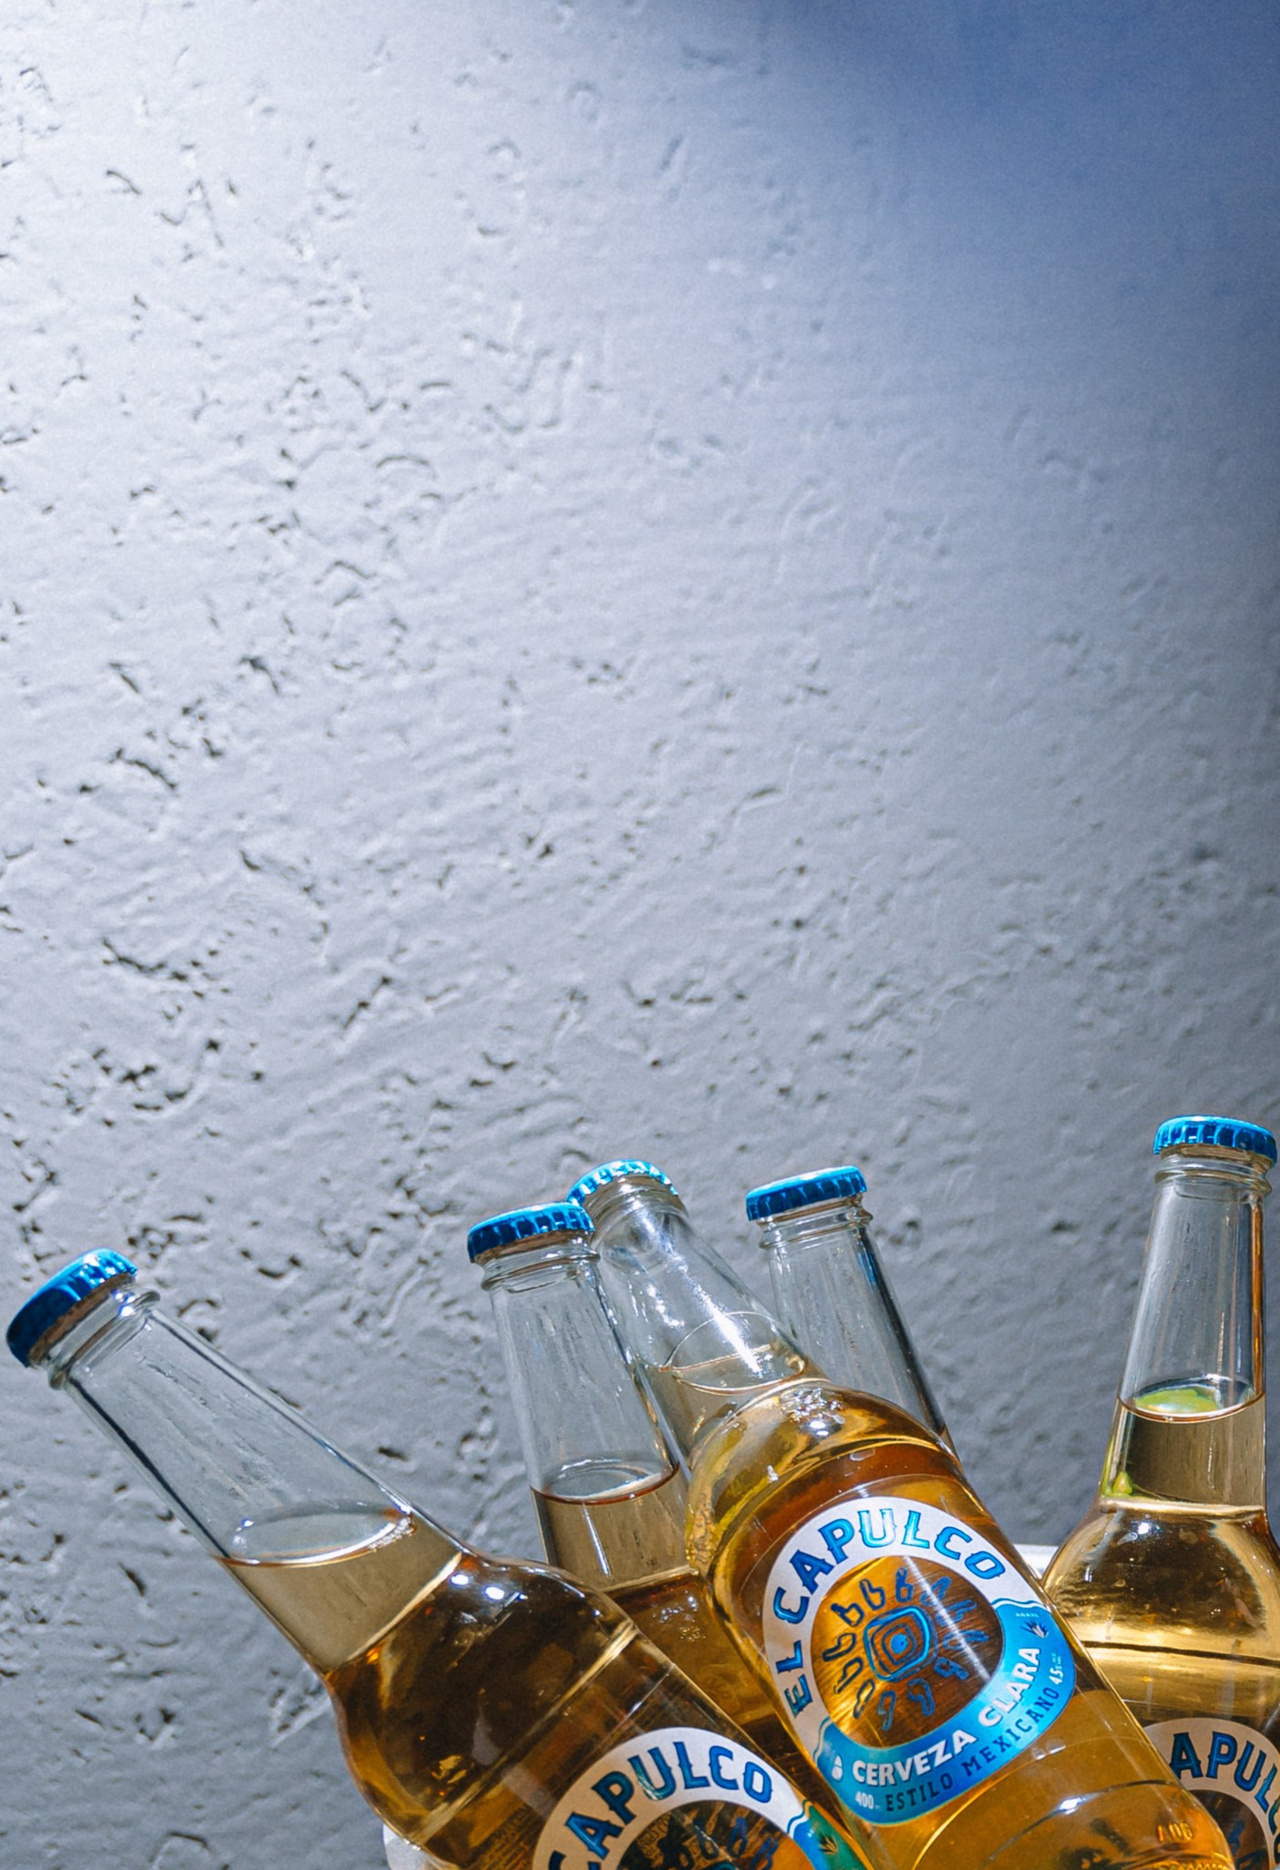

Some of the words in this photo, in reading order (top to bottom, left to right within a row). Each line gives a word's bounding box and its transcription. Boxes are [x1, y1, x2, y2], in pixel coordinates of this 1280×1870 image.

[773, 1508, 1006, 1625] CAPULCO
[776, 1640, 813, 1717] EL
[852, 1729, 977, 1787] CERVEZA
[978, 1647, 1041, 1728] CLARA
[886, 1773, 953, 1812] ESTILO
[961, 1686, 1060, 1777] MEXICANO
